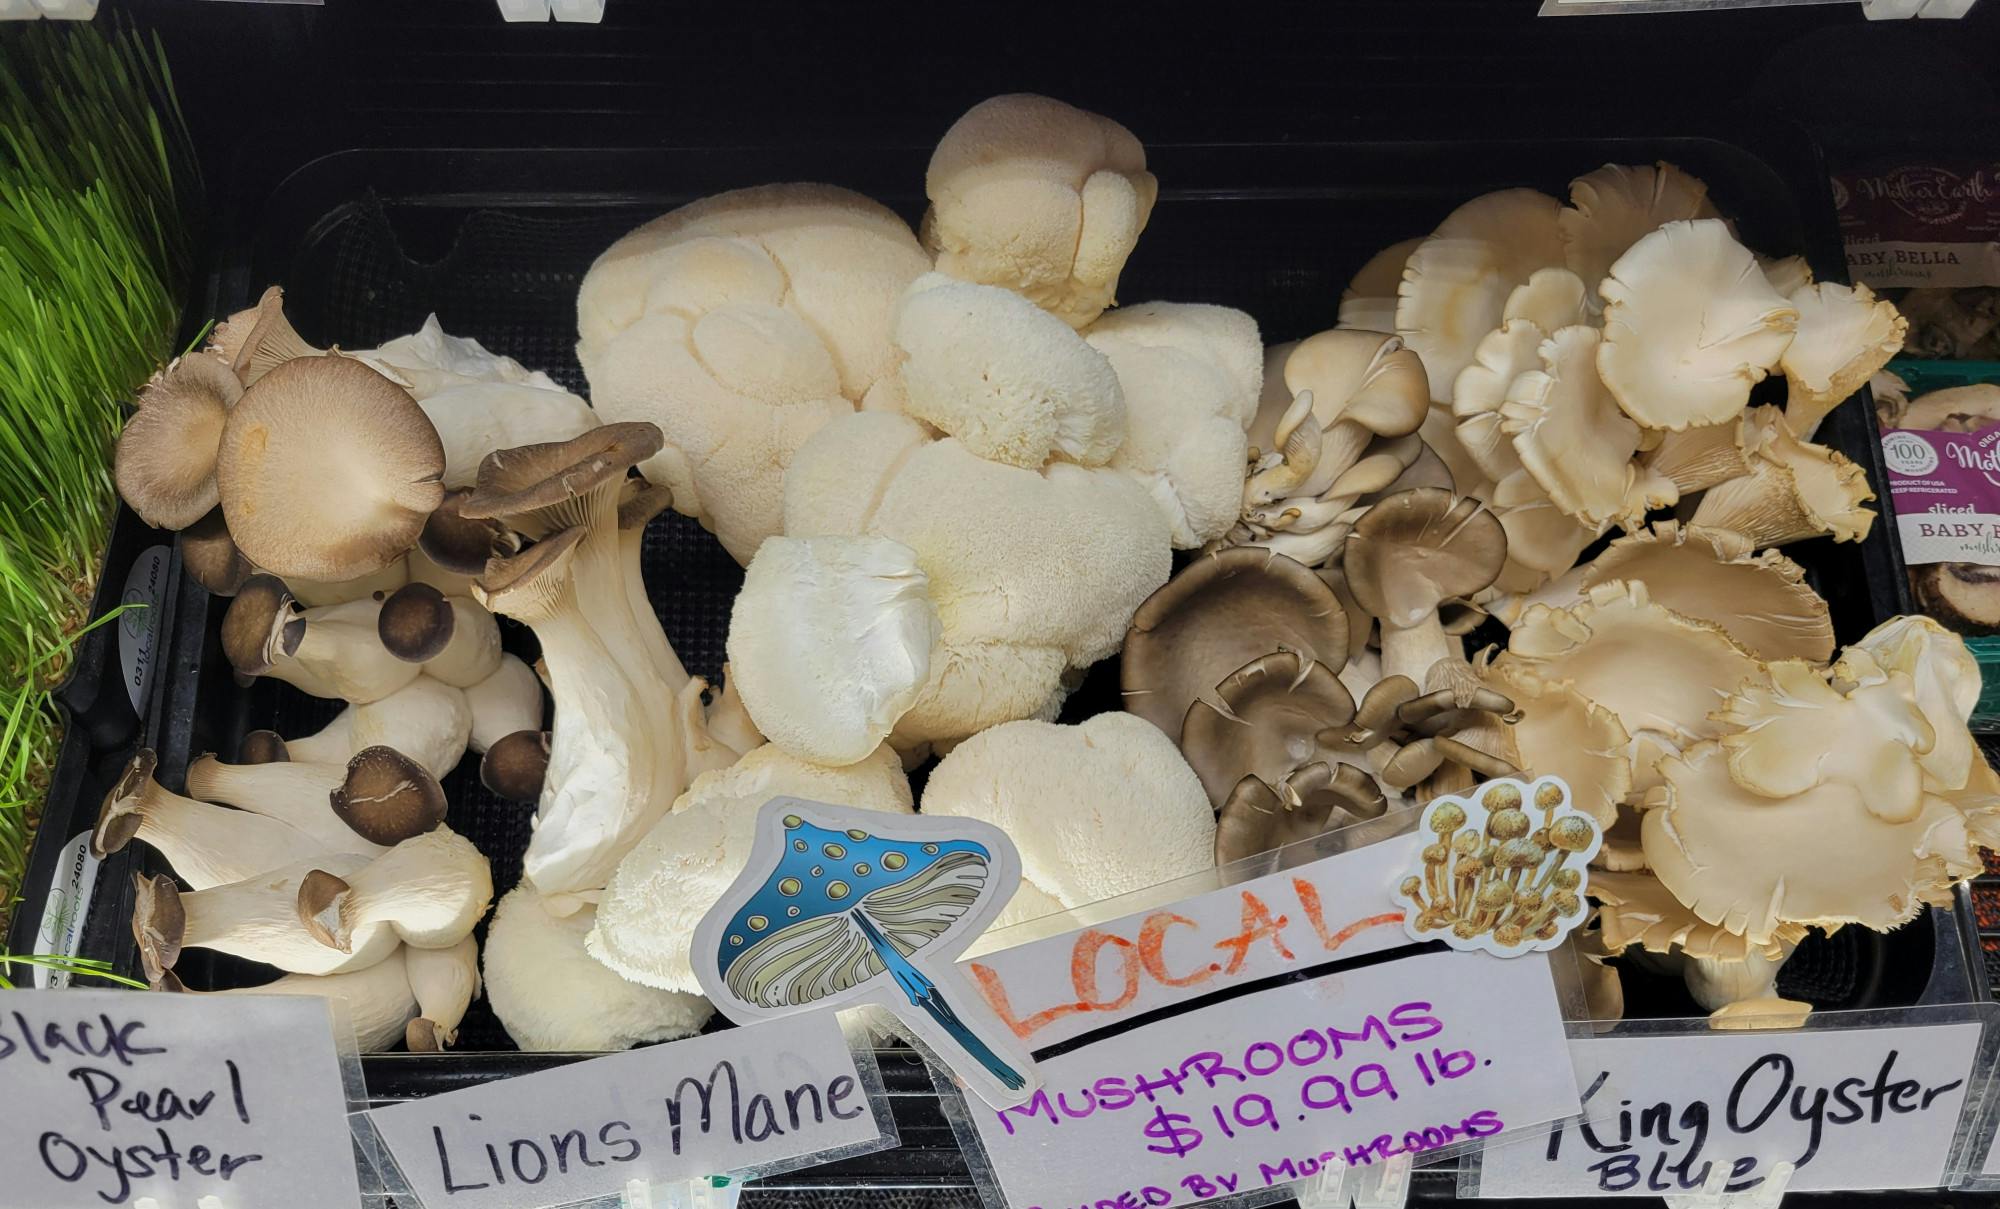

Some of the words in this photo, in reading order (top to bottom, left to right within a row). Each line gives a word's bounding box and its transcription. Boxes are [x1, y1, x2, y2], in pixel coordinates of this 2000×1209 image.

[1846, 251, 1887, 266] ABY
[1894, 250, 1961, 266] BELLA
[1890, 443, 1926, 460] 100
[1918, 523, 1984, 538] BABY
[1928, 503, 1976, 515] sliced
[147, 555, 161, 597] 24080
[133, 646, 147, 687] 0311
[71, 844, 87, 889] 24080
[971, 877, 1404, 1040] LOCAL
[68, 1059, 250, 1131] Pearl
[996, 1000, 1444, 1135] MUSHROOMS
[432, 1112, 643, 1195] Lions
[665, 1058, 865, 1155] Mane
[1142, 1062, 1399, 1158] $19.99
[1546, 1070, 1710, 1172] King
[1725, 1049, 1964, 1170] Oyster
[38, 1127, 263, 1204] Oyster
